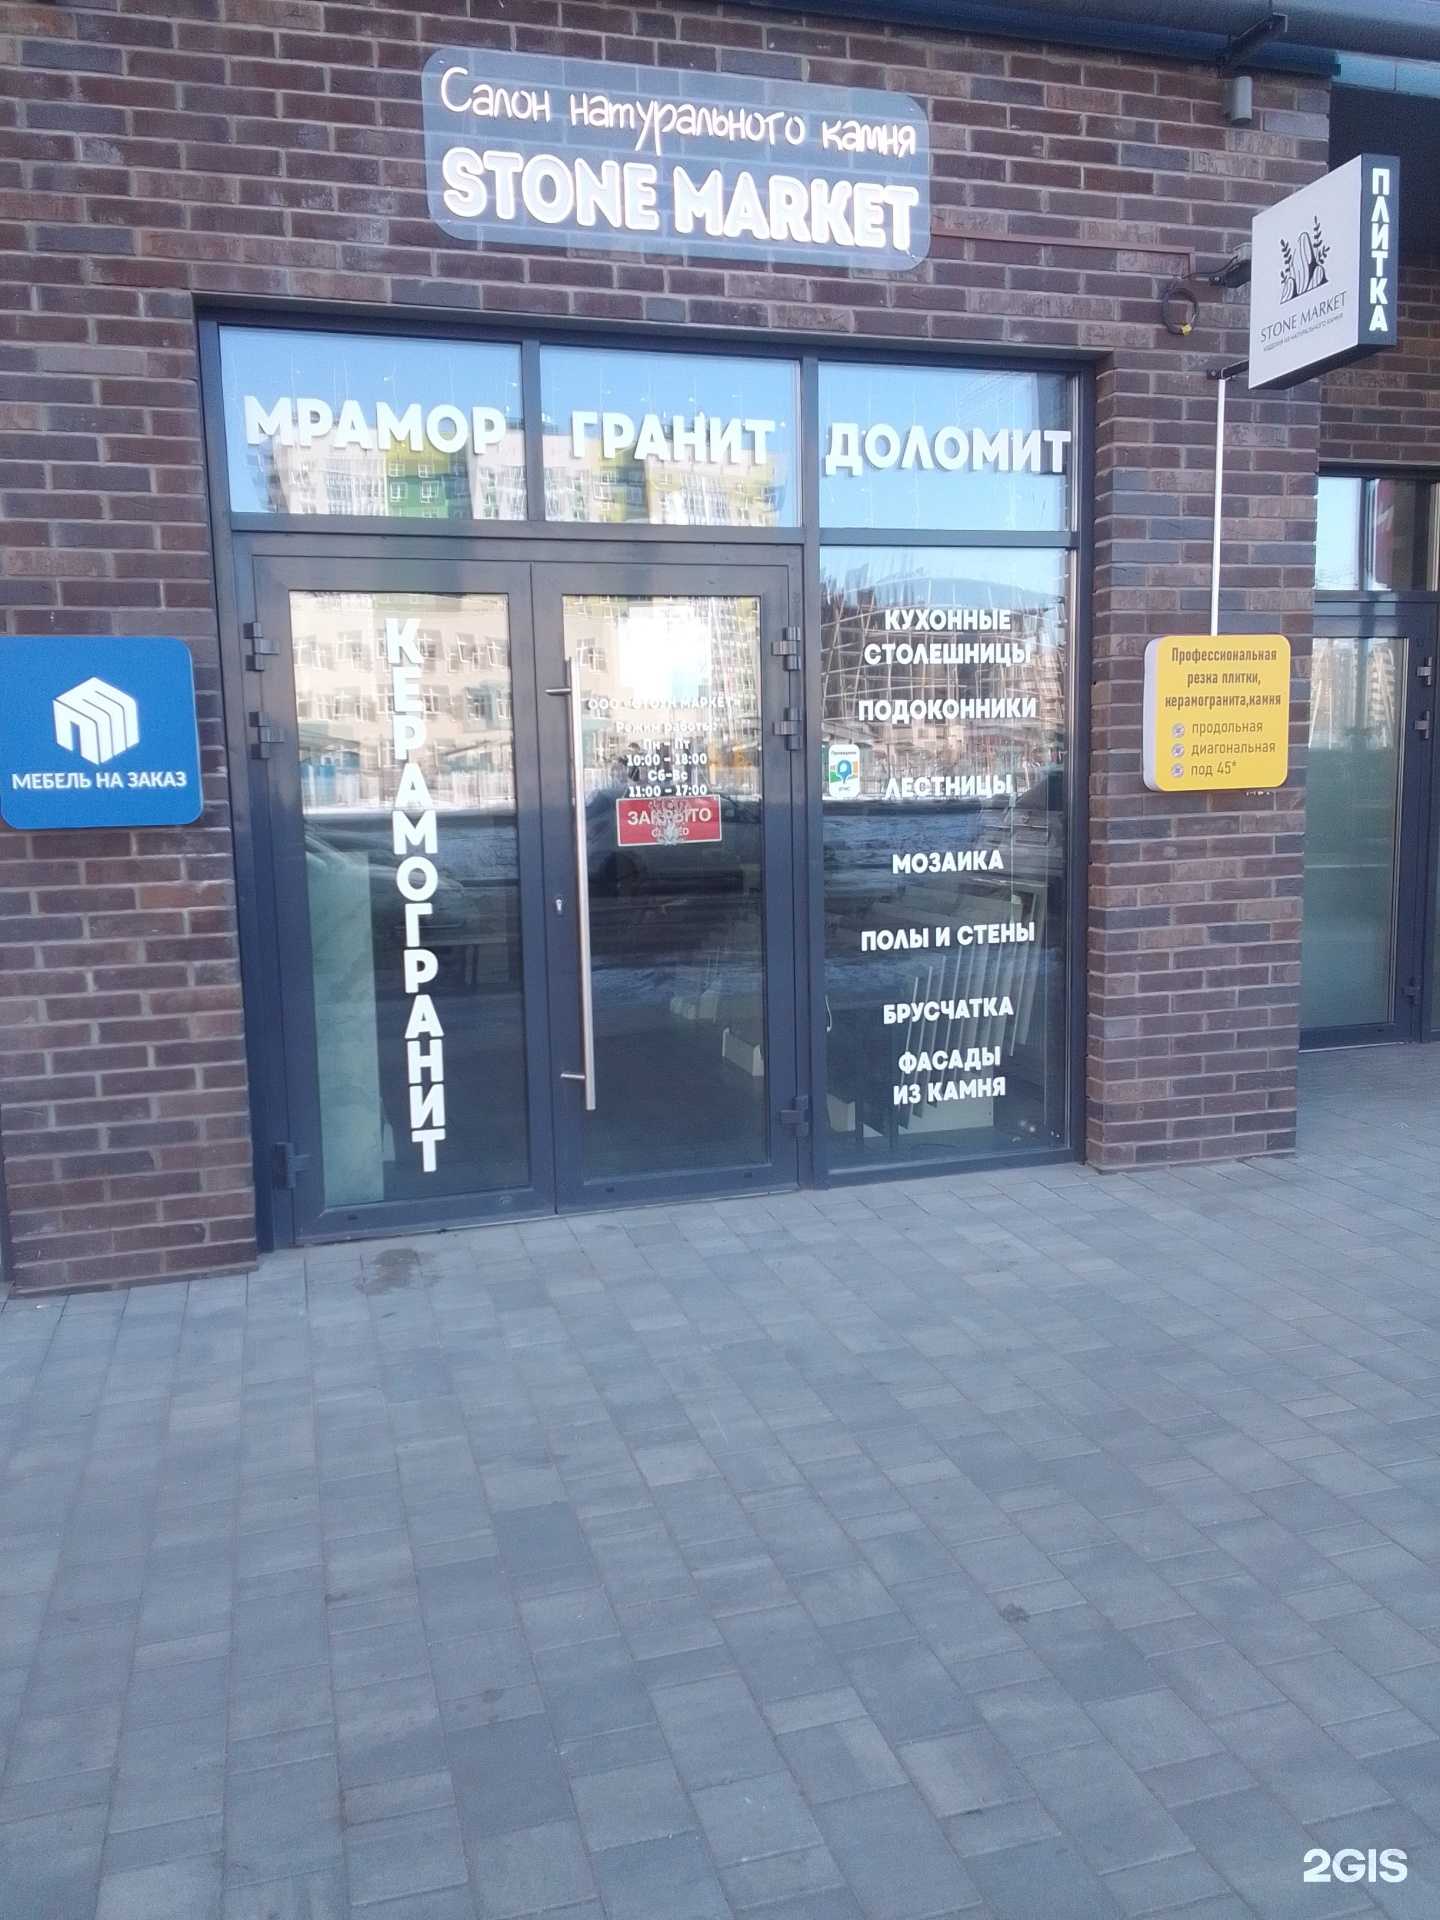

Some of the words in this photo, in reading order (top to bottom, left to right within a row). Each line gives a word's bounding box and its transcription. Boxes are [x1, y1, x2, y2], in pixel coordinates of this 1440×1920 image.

[440, 66, 551, 123] Салон
[569, 95, 806, 156] натурального
[821, 118, 918, 158] камня
[441, 147, 660, 232] STONE
[673, 165, 920, 250] MARKET
[1369, 167, 1391, 332] ПЛИТКА
[1260, 314, 1297, 343] STONE
[1300, 290, 1347, 326] MARKET
[244, 396, 506, 454] МРАМОР
[572, 411, 776, 464] ГРАНИТ
[825, 422, 1072, 476] ДОЛОМИТ
[884, 608, 1012, 631] КУХОННЫЕ
[863, 642, 1034, 667] СТОЛЕШНИЦЫ
[1171, 647, 1277, 665] Профессиональная
[1187, 673, 1219, 688] резка
[1221, 672, 1262, 686] плитки,
[858, 697, 1037, 724] ПОДОКОННИКИ
[1191, 721, 1263, 736] продольная
[643, 739, 661, 751] Пн
[1191, 741, 1276, 756] диагональная
[627, 755, 660, 767] 10:00
[675, 753, 707, 765] 18:00
[1191, 764, 1213, 777] под
[12, 773, 91, 789] МЕБЕЛЬ
[96, 773, 123, 788] НА
[127, 771, 187, 788] ЗАКАЗ
[629, 785, 661, 798] 11:00
[675, 784, 707, 796] 17:00
[885, 775, 1013, 799] ЛЕСТНИЦЫ
[892, 850, 1004, 874] МОЗАИКА
[385, 617, 446, 1173] КЕРАМОГРАНИТ
[861, 928, 929, 951] ПОЛЫ
[936, 927, 950, 946] И
[957, 922, 1035, 945] СТЕНЫ
[884, 997, 1014, 1024] БРУСЧАТКА
[898, 1046, 1001, 1073] ФАСАДЫ
[894, 1083, 921, 1105] ИЗ
[928, 1077, 1006, 1101] КАМНЯ
